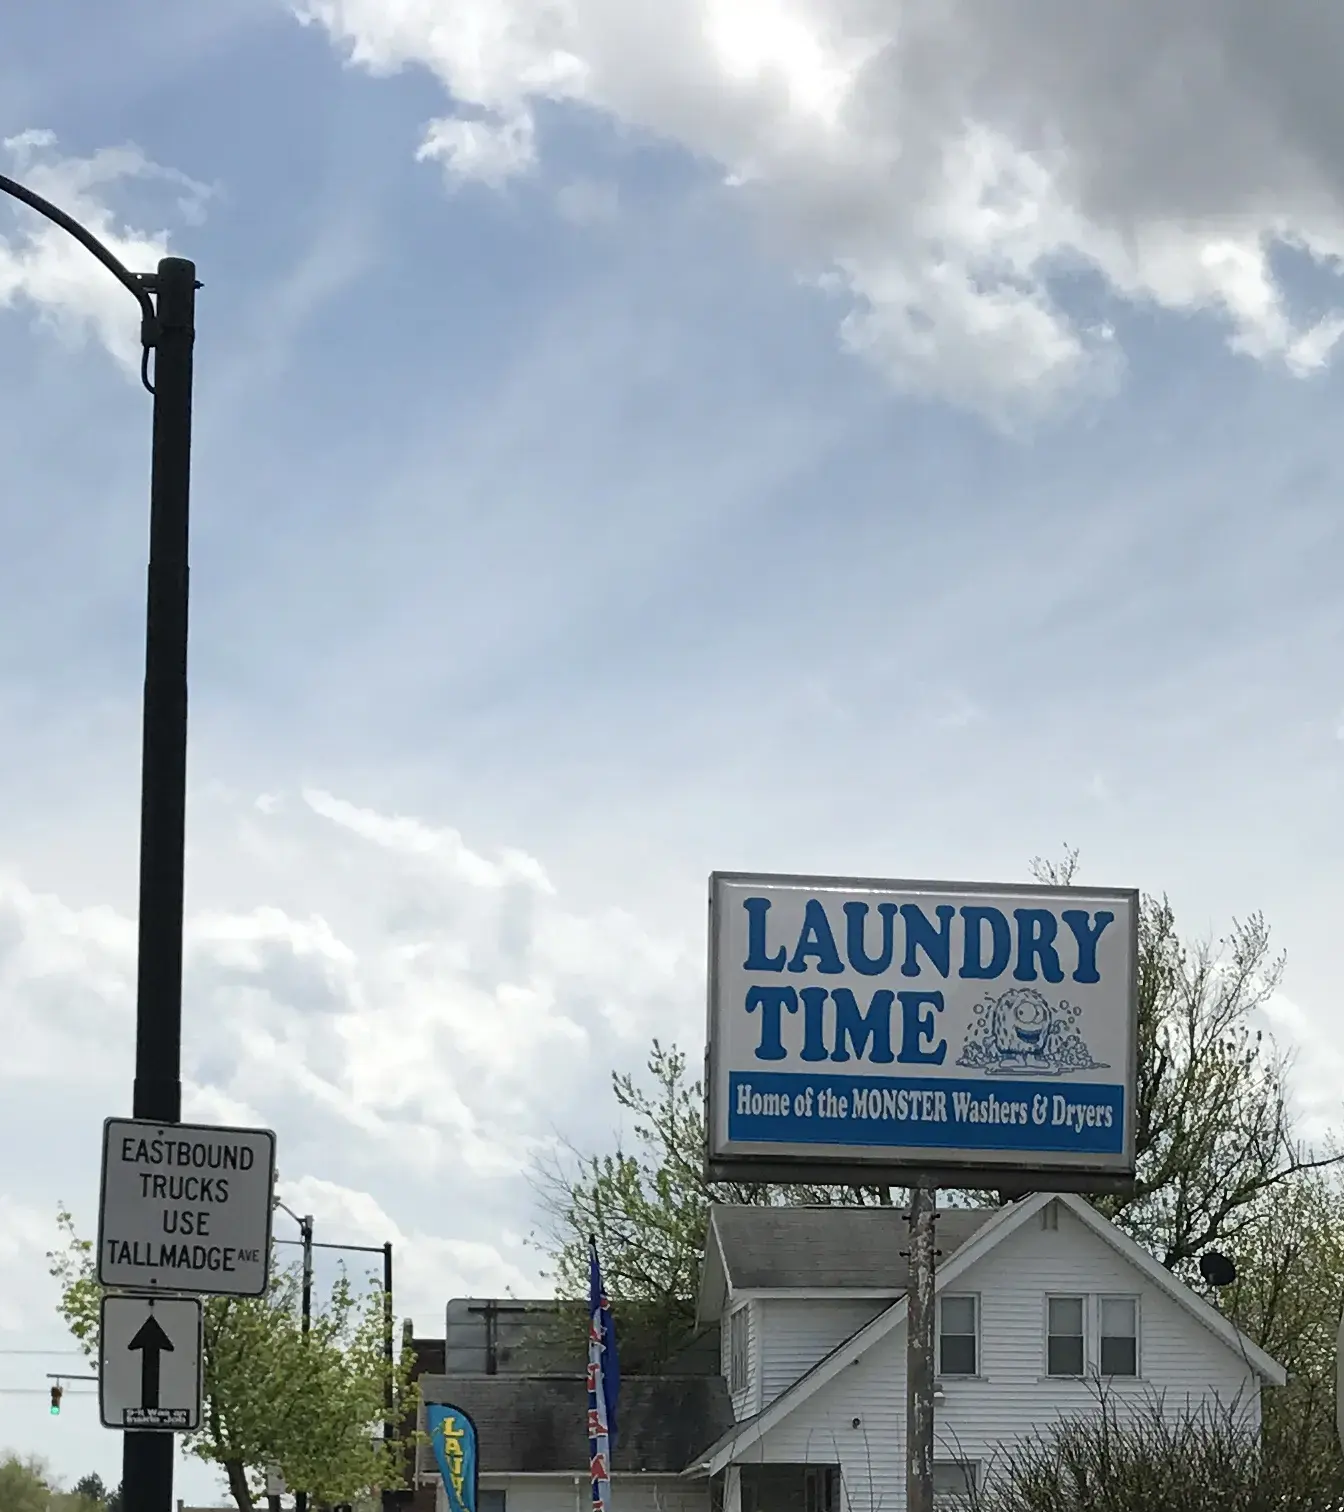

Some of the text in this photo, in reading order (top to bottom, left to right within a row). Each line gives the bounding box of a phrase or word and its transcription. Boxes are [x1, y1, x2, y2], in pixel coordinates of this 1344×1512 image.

[743, 897, 1115, 984] LAUNDRY
[745, 985, 948, 1066] TIME
[736, 1084, 1113, 1134] Home of the MONSTER Washers & Dryers
[121, 1138, 254, 1171] EASTBOUND
[140, 1173, 229, 1203] TRUCKS
[163, 1210, 210, 1236] USE
[108, 1240, 259, 1271] TALLMADGE AVE
